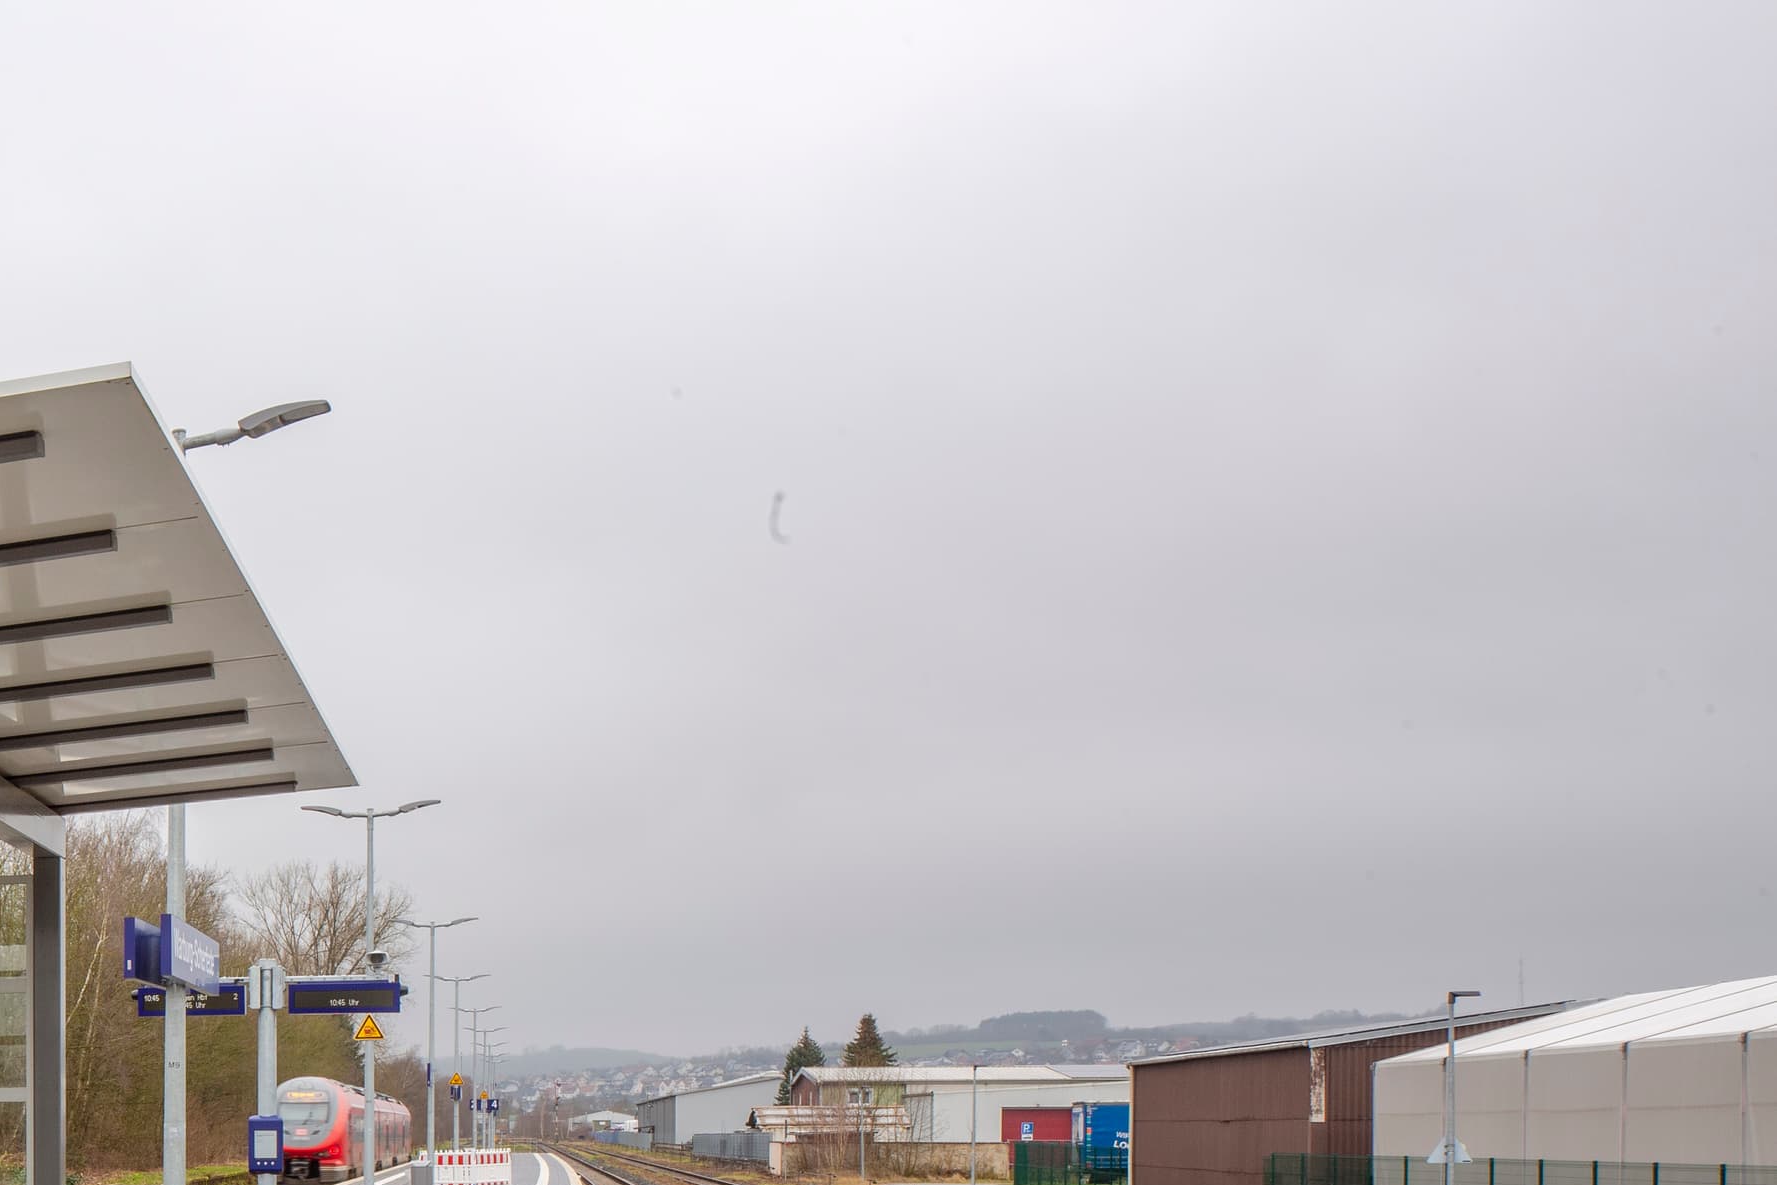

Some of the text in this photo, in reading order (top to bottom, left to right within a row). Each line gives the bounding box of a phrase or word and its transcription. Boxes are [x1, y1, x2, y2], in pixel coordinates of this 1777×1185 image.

[233, 992, 238, 1000] 2
[195, 1001, 206, 1009] Uhr
[330, 999, 360, 1007] 10:45 Uhr
